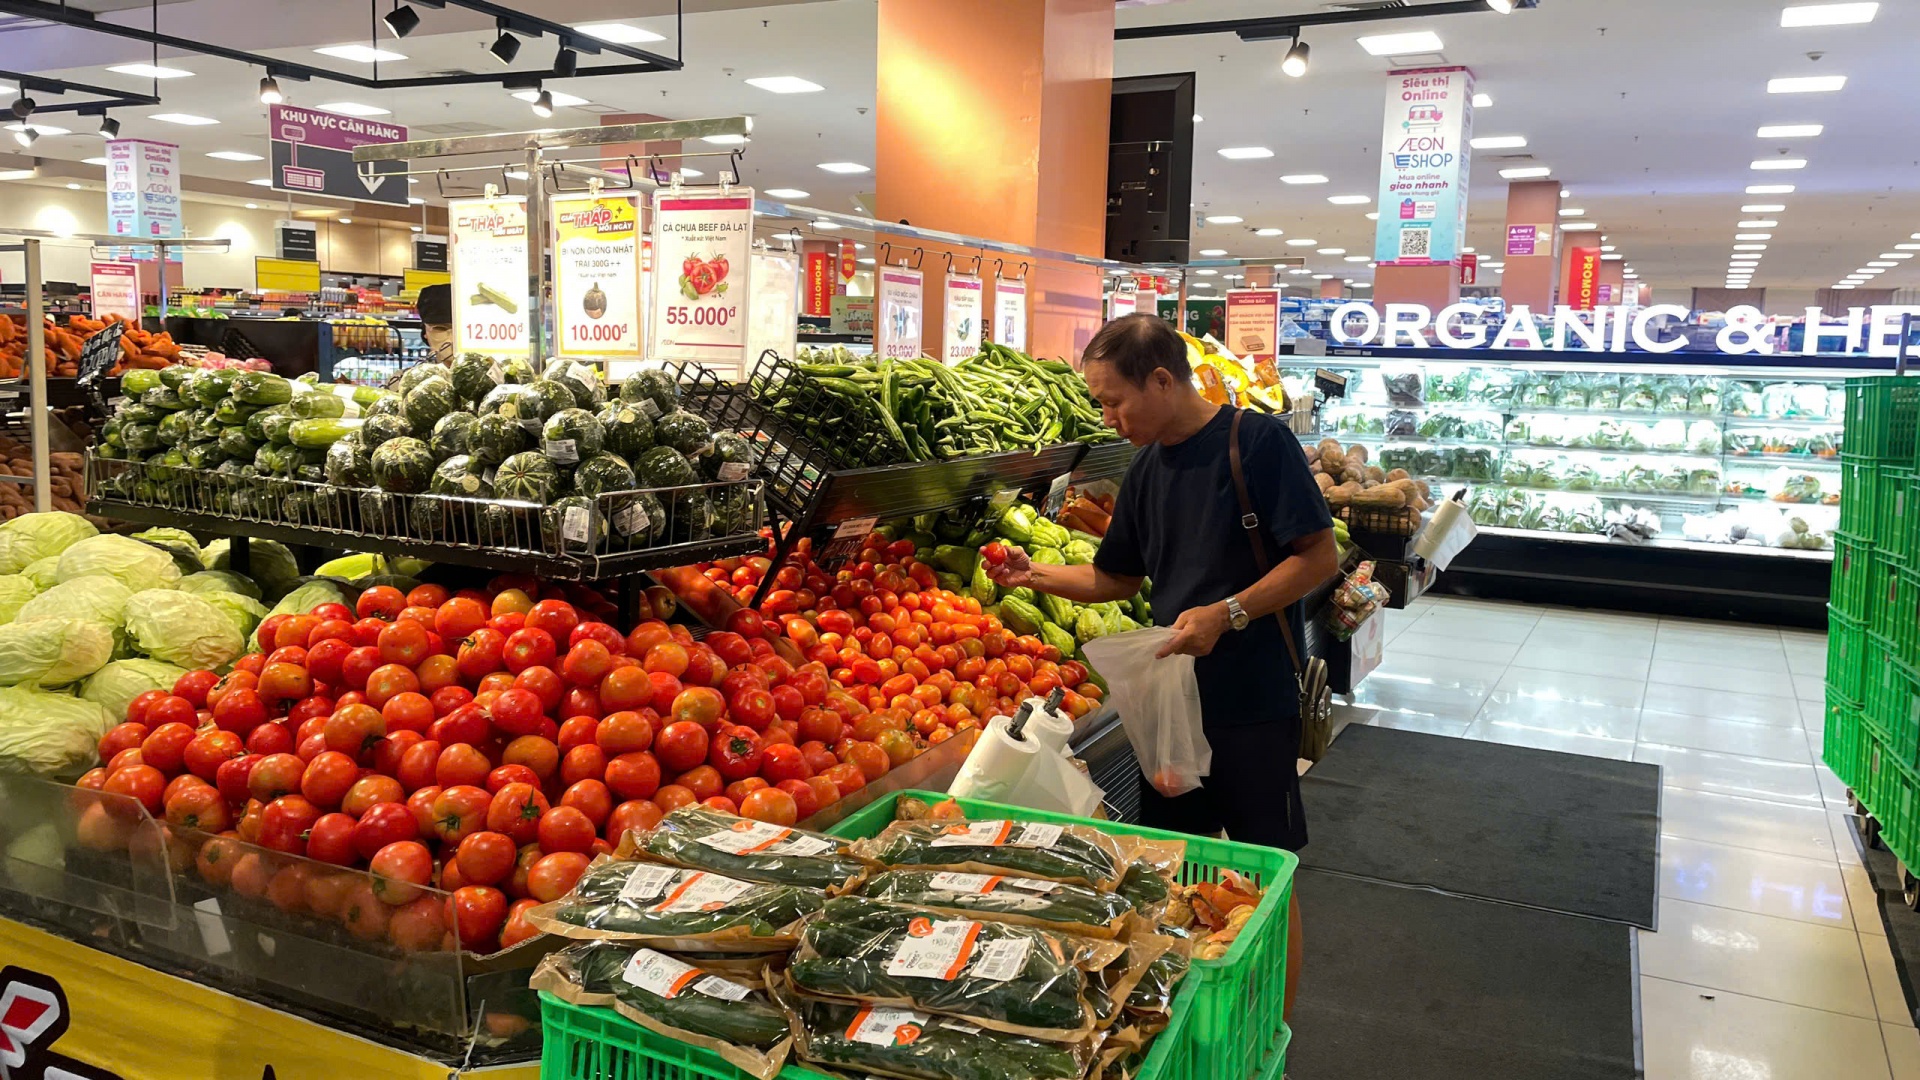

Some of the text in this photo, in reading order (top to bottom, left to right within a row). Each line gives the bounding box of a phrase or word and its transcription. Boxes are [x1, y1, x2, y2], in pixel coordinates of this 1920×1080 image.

[1402, 76, 1450, 88] Siêu thị
[1402, 89, 1448, 101] Online
[280, 109, 400, 140] KHU VỰC CÂN HÀNG
[145, 154, 171, 163] Online
[1390, 180, 1448, 192] giao nhanh
[574, 204, 612, 227] THẤP
[662, 221, 748, 234] CÀ CHUA BEEF ĐÀ LẠT
[666, 306, 736, 326] 55.000đ
[466, 322, 524, 340] 12.000đ
[571, 323, 628, 342] 10.000đ
[1330, 302, 1920, 358] ORGANIC & HE
